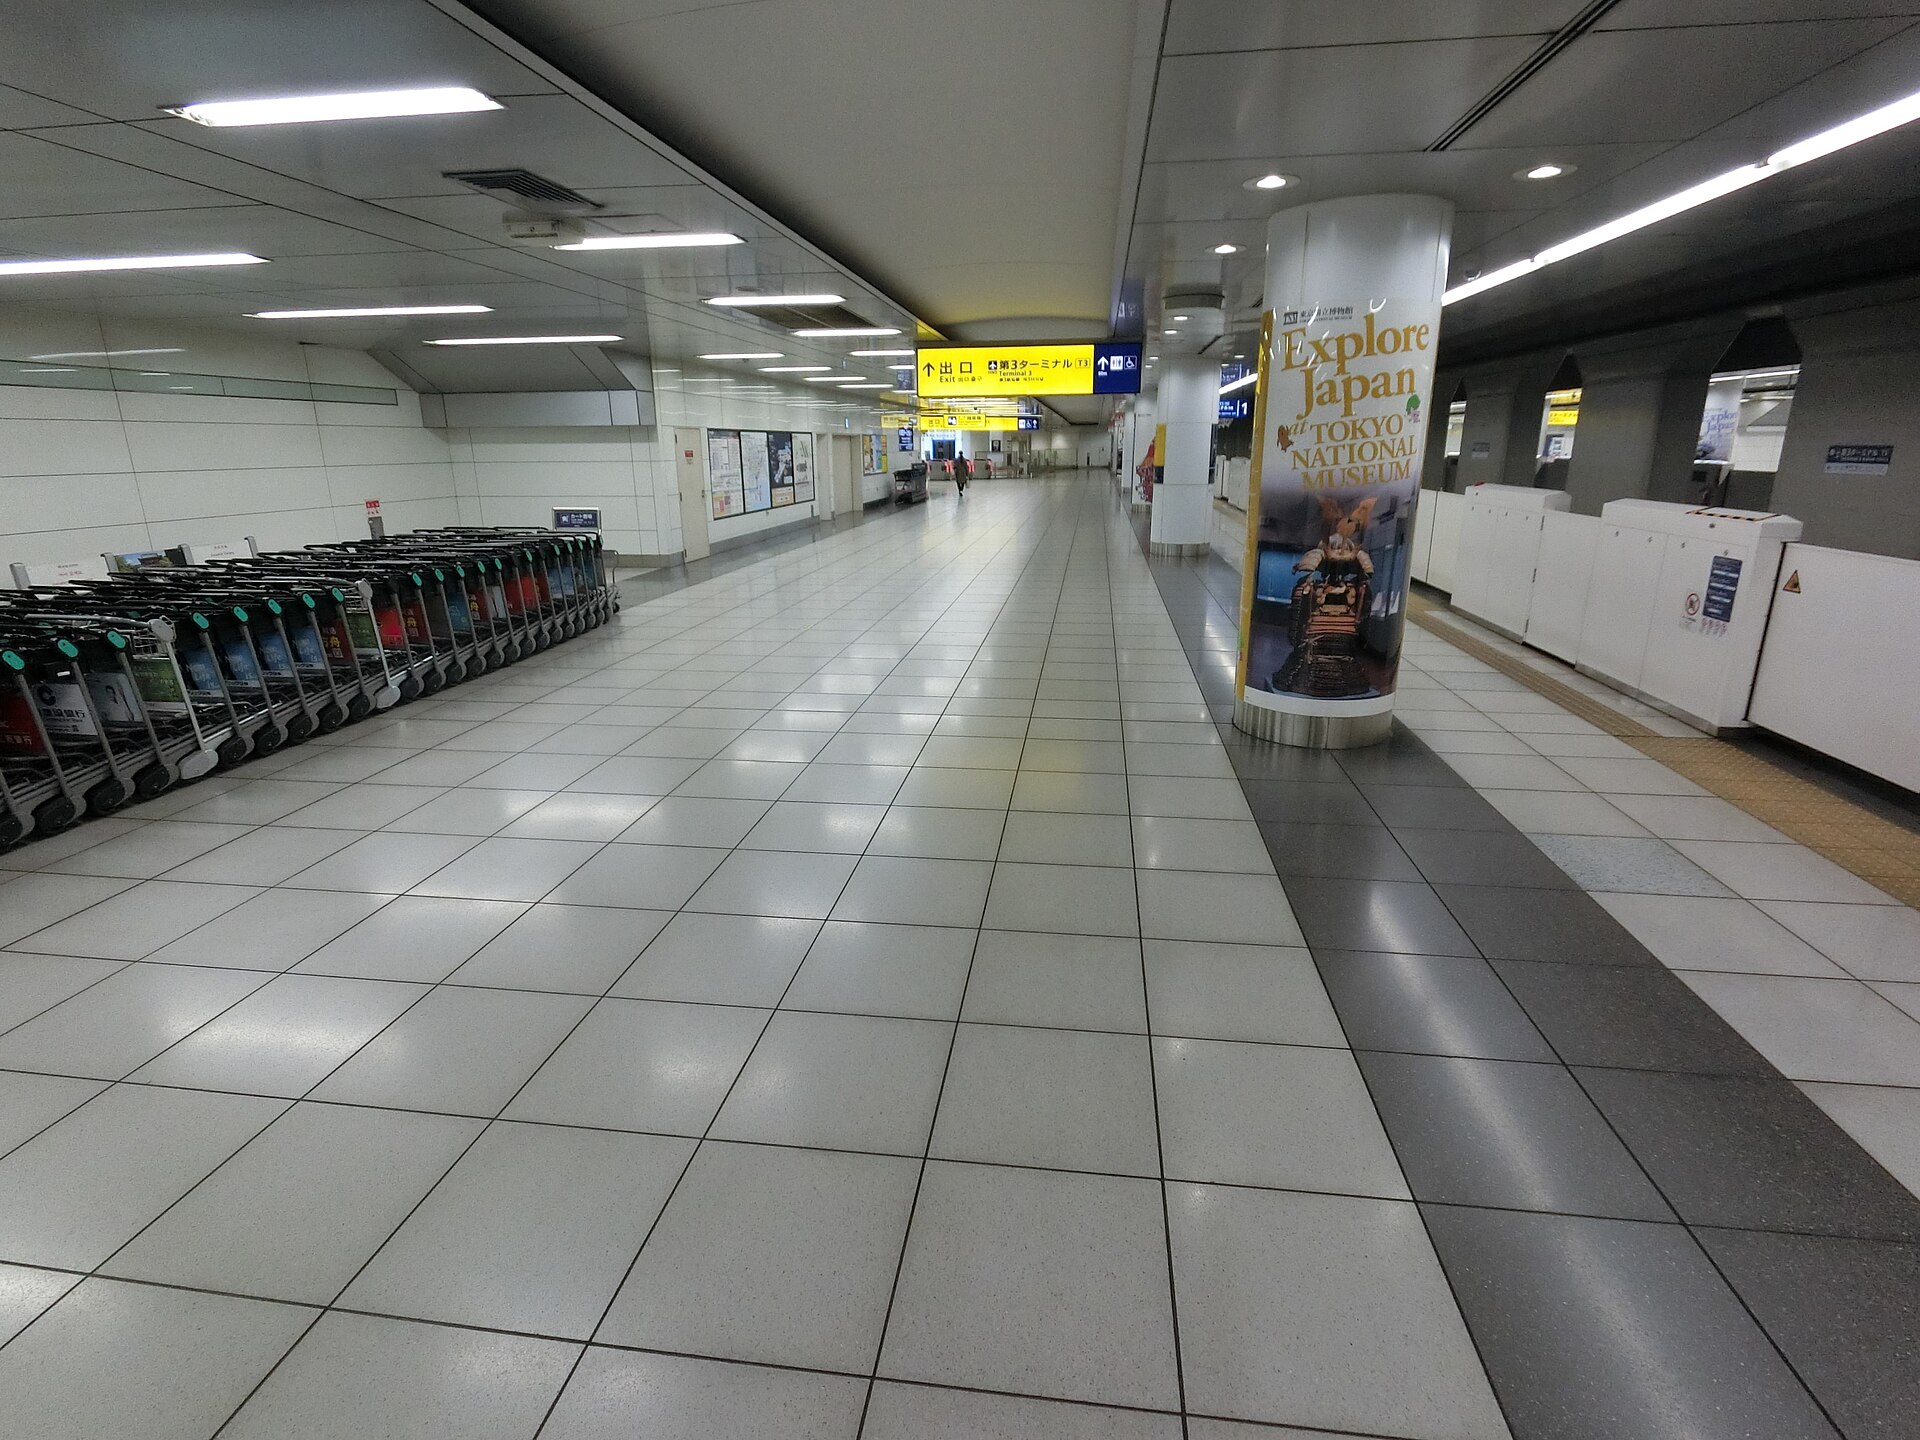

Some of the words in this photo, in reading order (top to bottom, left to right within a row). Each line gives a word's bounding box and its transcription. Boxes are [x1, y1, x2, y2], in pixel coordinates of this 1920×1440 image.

[1281, 313, 1429, 376] Explore
[939, 361, 973, 375] 出口
[999, 359, 1072, 370] 第3ターミナル
[1242, 402, 1248, 415] 1
[1296, 367, 1416, 420] Japan
[1289, 421, 1308, 436] at
[1310, 413, 1403, 445] TOKYO
[1291, 434, 1417, 471] NATIONAL
[1301, 458, 1411, 491] MUSEUM
